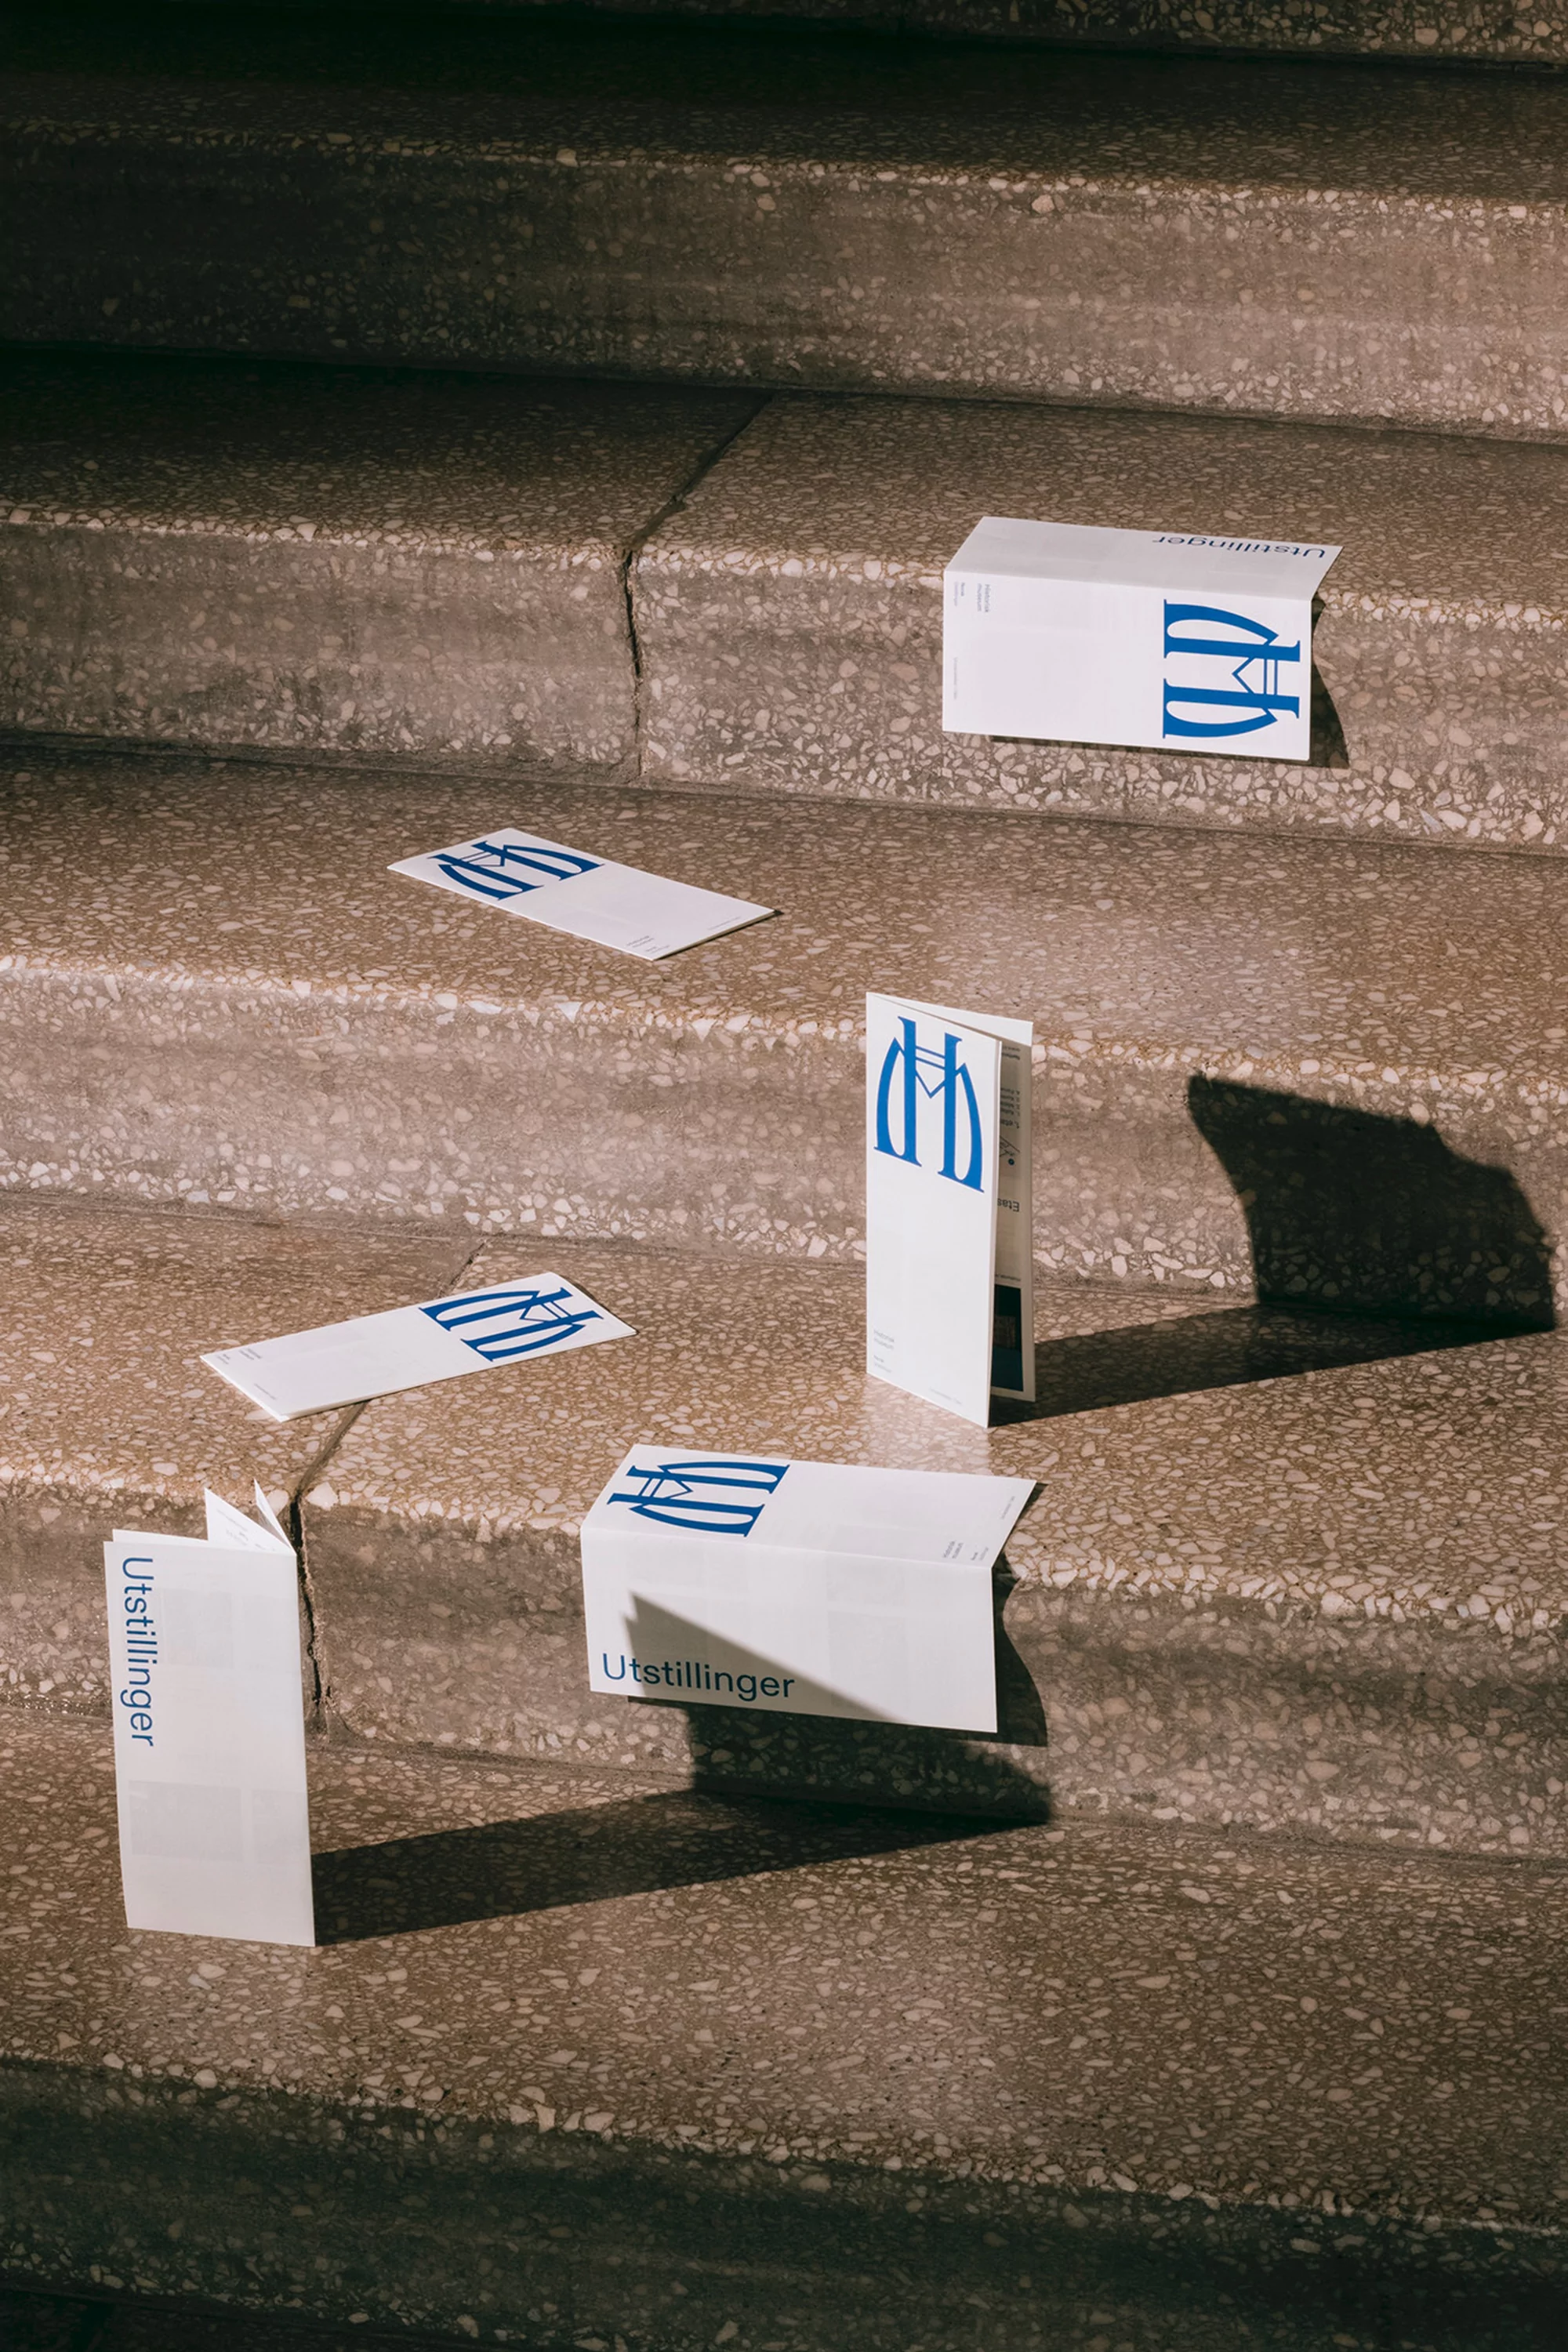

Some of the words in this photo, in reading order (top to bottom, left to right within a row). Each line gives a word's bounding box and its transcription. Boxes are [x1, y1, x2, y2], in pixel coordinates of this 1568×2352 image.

[1152, 536, 1326, 558] Utstillinger
[120, 1556, 158, 1747] Utstillinger
[602, 1653, 795, 1702] Utstillinger
